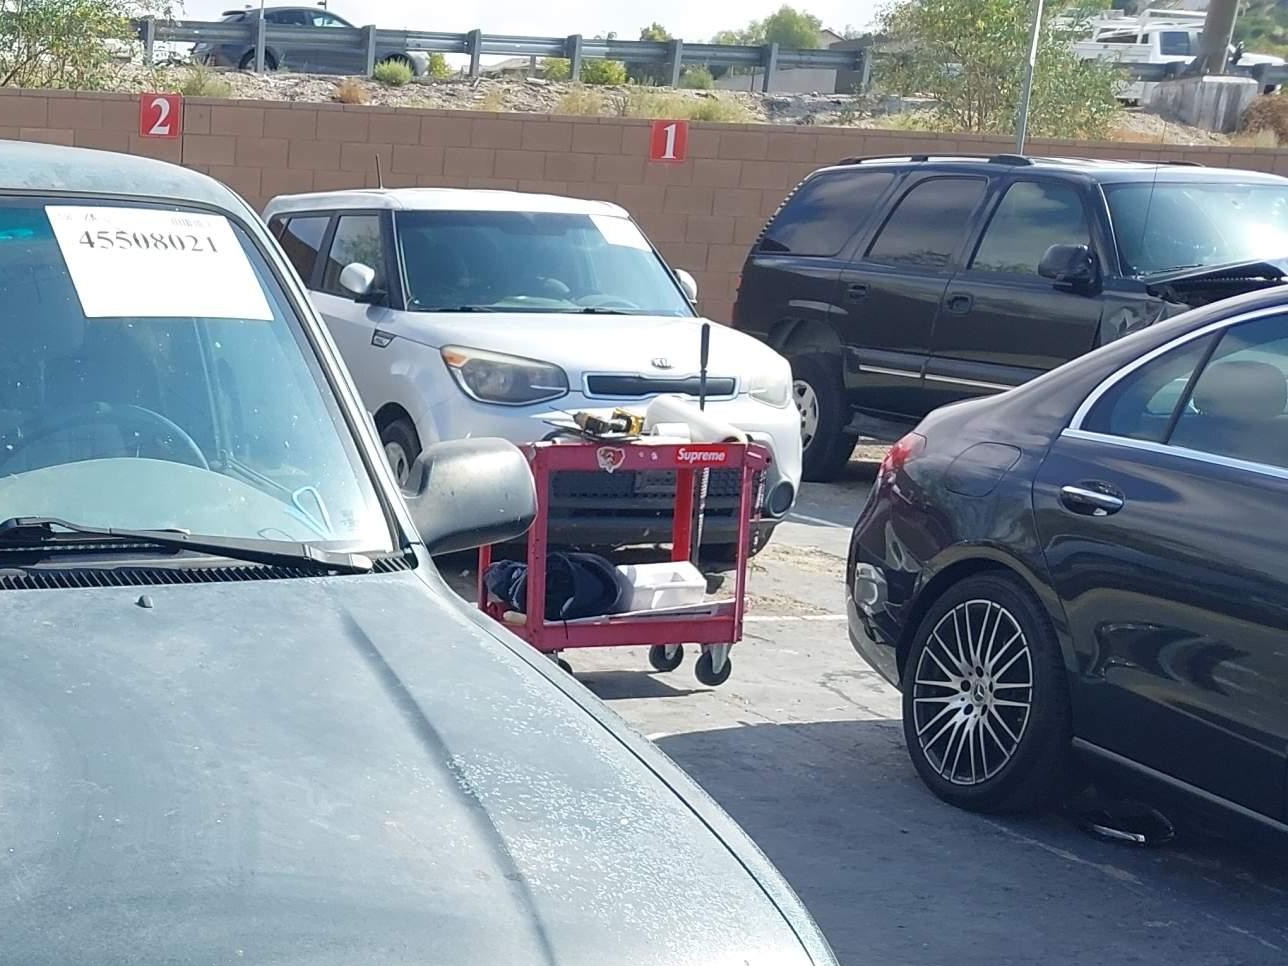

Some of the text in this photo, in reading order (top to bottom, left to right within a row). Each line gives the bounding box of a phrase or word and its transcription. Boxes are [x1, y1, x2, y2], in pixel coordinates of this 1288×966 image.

[149, 97, 170, 135] 2
[661, 123, 677, 159] 1
[79, 229, 218, 253] 45508021
[677, 448, 726, 464] Supreme
